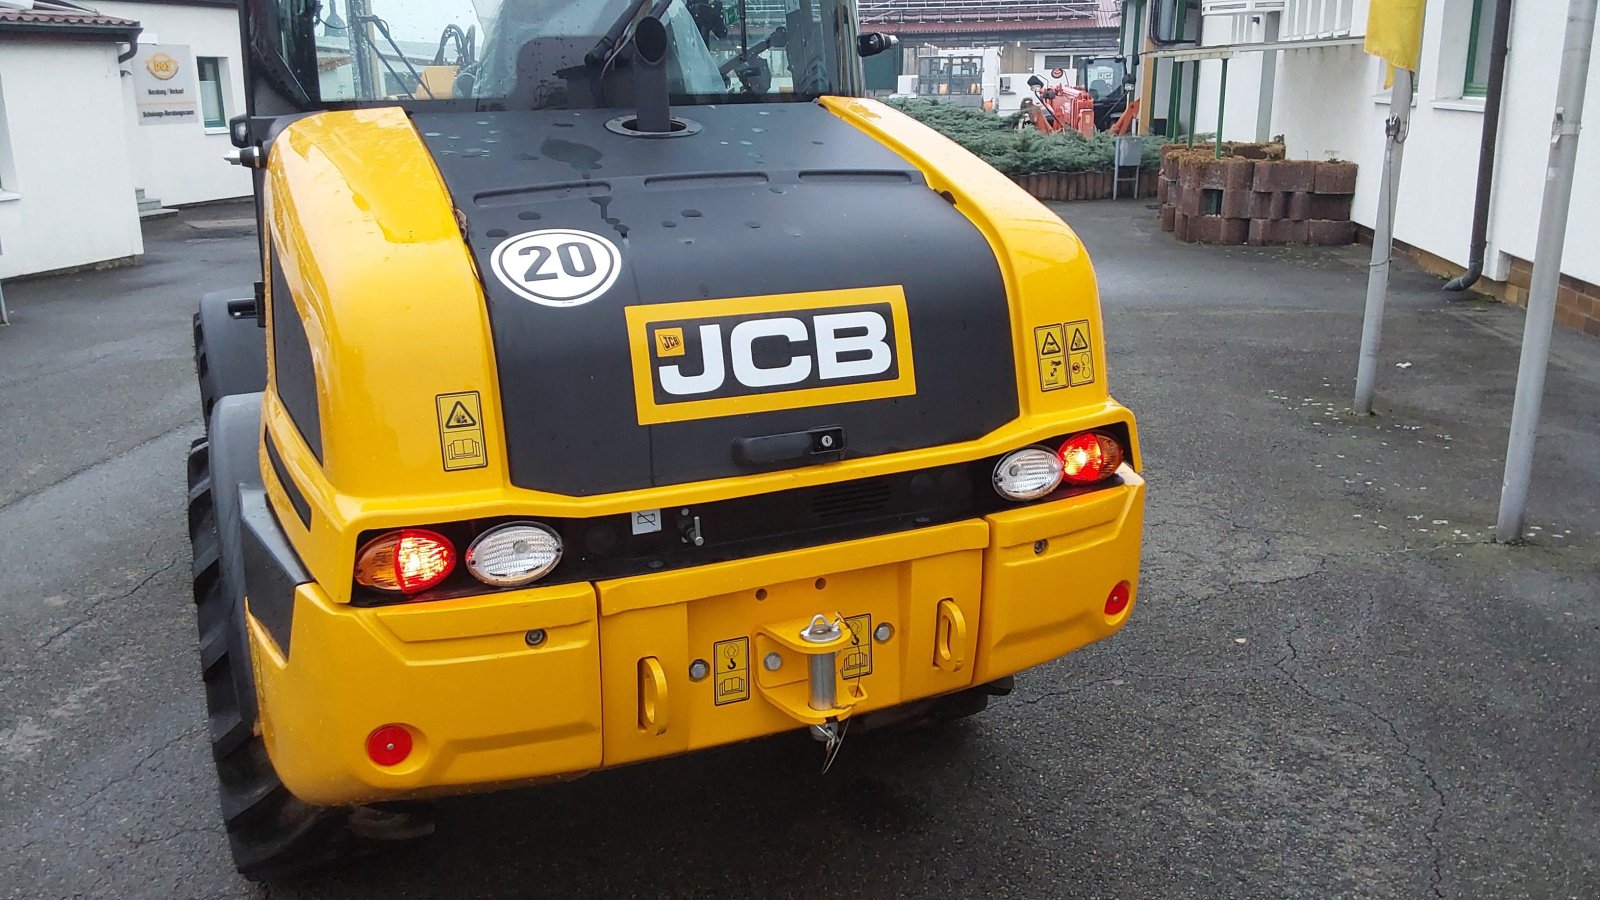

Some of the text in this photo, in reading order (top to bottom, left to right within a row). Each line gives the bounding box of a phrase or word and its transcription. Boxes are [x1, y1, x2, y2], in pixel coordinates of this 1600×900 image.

[518, 241, 597, 282] 20
[658, 311, 892, 395] JCB
[662, 335, 681, 349] JCB
